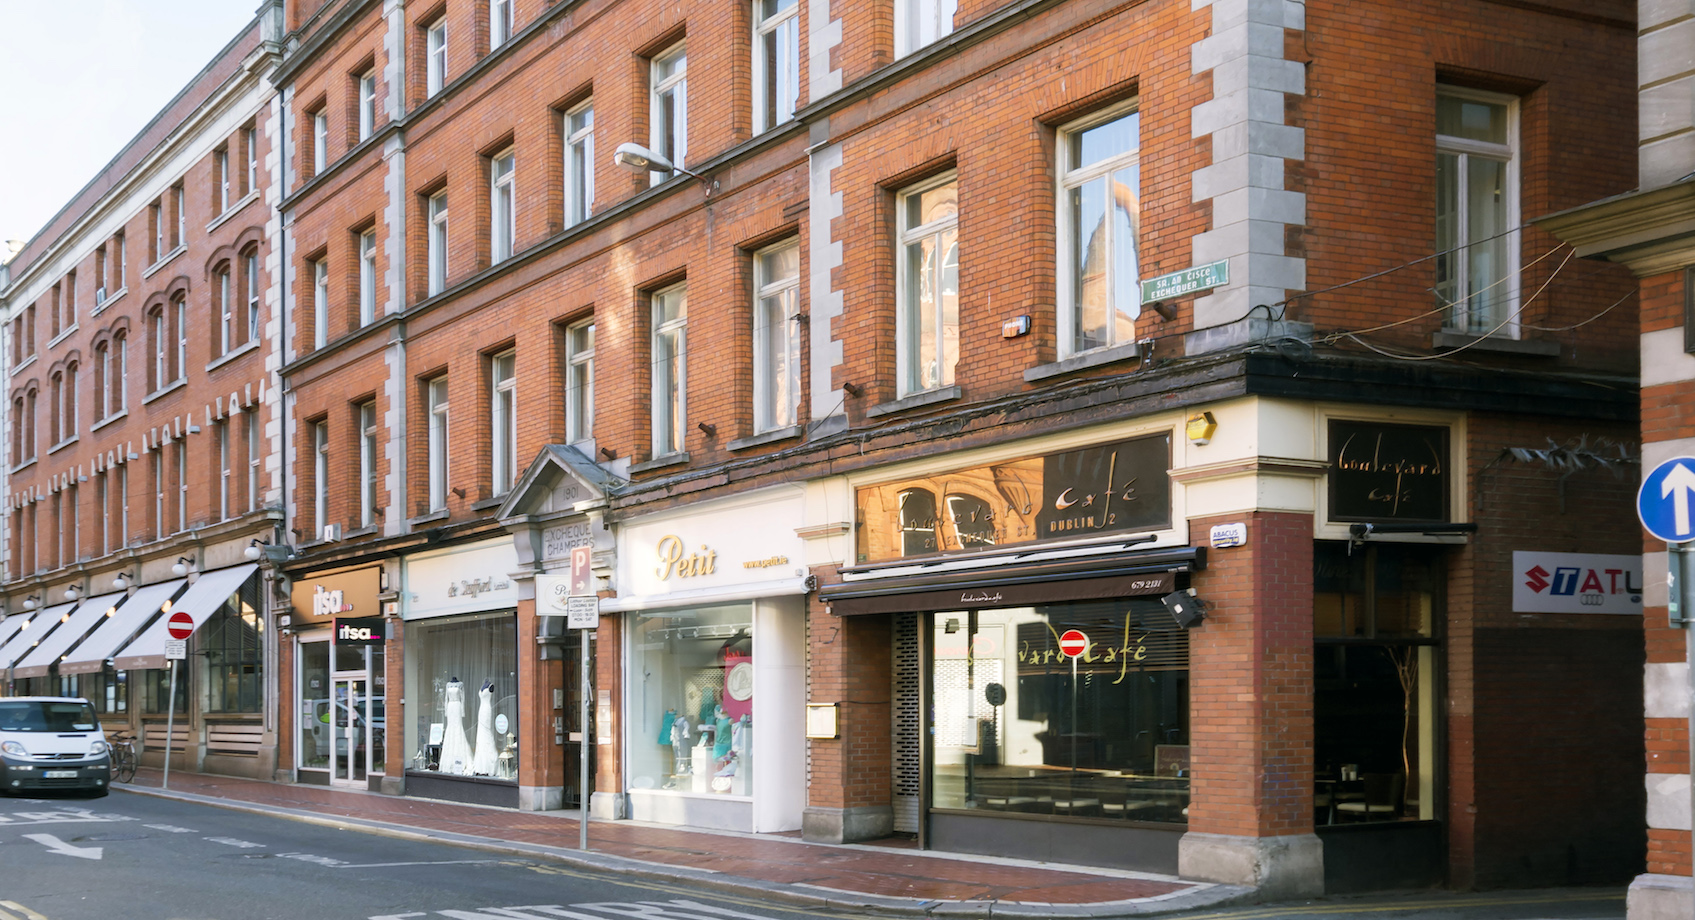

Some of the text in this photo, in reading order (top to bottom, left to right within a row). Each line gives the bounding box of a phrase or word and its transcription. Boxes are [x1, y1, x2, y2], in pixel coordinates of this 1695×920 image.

[1151, 275, 1219, 299] EXCHEQUER ST.
[563, 486, 579, 500] 1901
[544, 523, 591, 542] EXCHEQUE
[924, 537, 936, 549] 27
[946, 528, 1008, 547] EXCHEQUER
[1050, 516, 1094, 532] DUBLIN
[1109, 513, 1116, 525] 2
[1213, 529, 1239, 538] ABACUS
[576, 551, 586, 577] P
[655, 534, 717, 581] Petit
[743, 556, 788, 569] www.petit.ie
[555, 584, 571, 595] Pet
[1525, 565, 1643, 595] STATU
